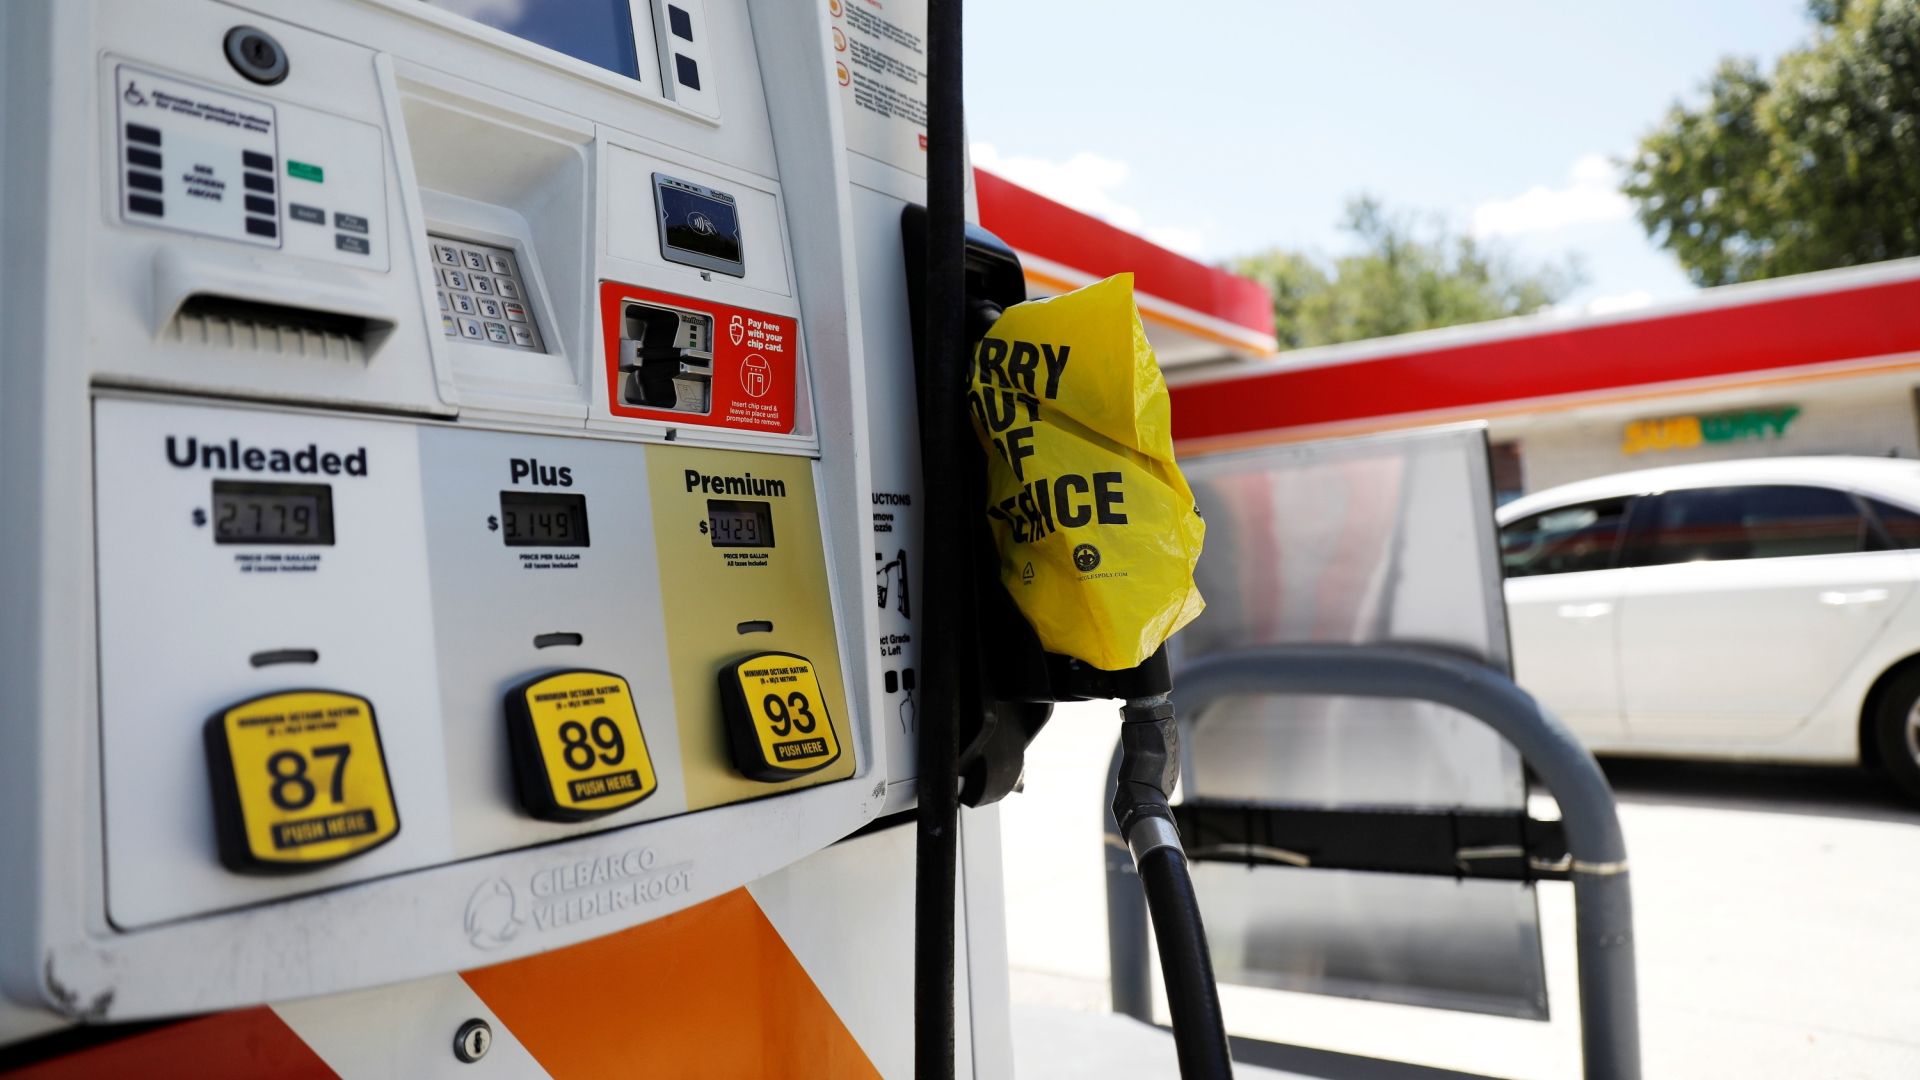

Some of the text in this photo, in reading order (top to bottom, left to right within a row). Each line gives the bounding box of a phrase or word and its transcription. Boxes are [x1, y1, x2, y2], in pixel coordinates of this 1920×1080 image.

[445, 253, 452, 262] 2
[453, 277, 460, 286] 5
[480, 282, 487, 290] 6
[461, 301, 468, 310] 8
[487, 306, 494, 314] 9
[469, 326, 476, 335] 0
[748, 318, 779, 331] Pay here
[748, 329, 782, 342] with your
[748, 339, 783, 352] chip card.
[748, 402, 759, 410] chip
[1621, 406, 1800, 456] SUBWAY
[166, 435, 367, 476] Unleaded
[510, 458, 573, 487] Plus
[685, 469, 786, 497] Premium
[872, 492, 911, 506] UCTIONS
[192, 508, 207, 528] $
[487, 514, 498, 532] $
[700, 520, 708, 535] $
[874, 522, 892, 532] ozzle
[744, 669, 769, 677] MINIMUM
[790, 666, 808, 674] RATING
[763, 692, 816, 737] 93
[558, 716, 625, 771] 89
[779, 741, 823, 757] PUSH HERE
[266, 743, 352, 812] 87
[574, 774, 634, 798] PUSH HERE
[280, 814, 367, 846] PUSH HERE
[530, 847, 654, 898] GILBARCO
[532, 870, 692, 932] VEEDER-ROOT
